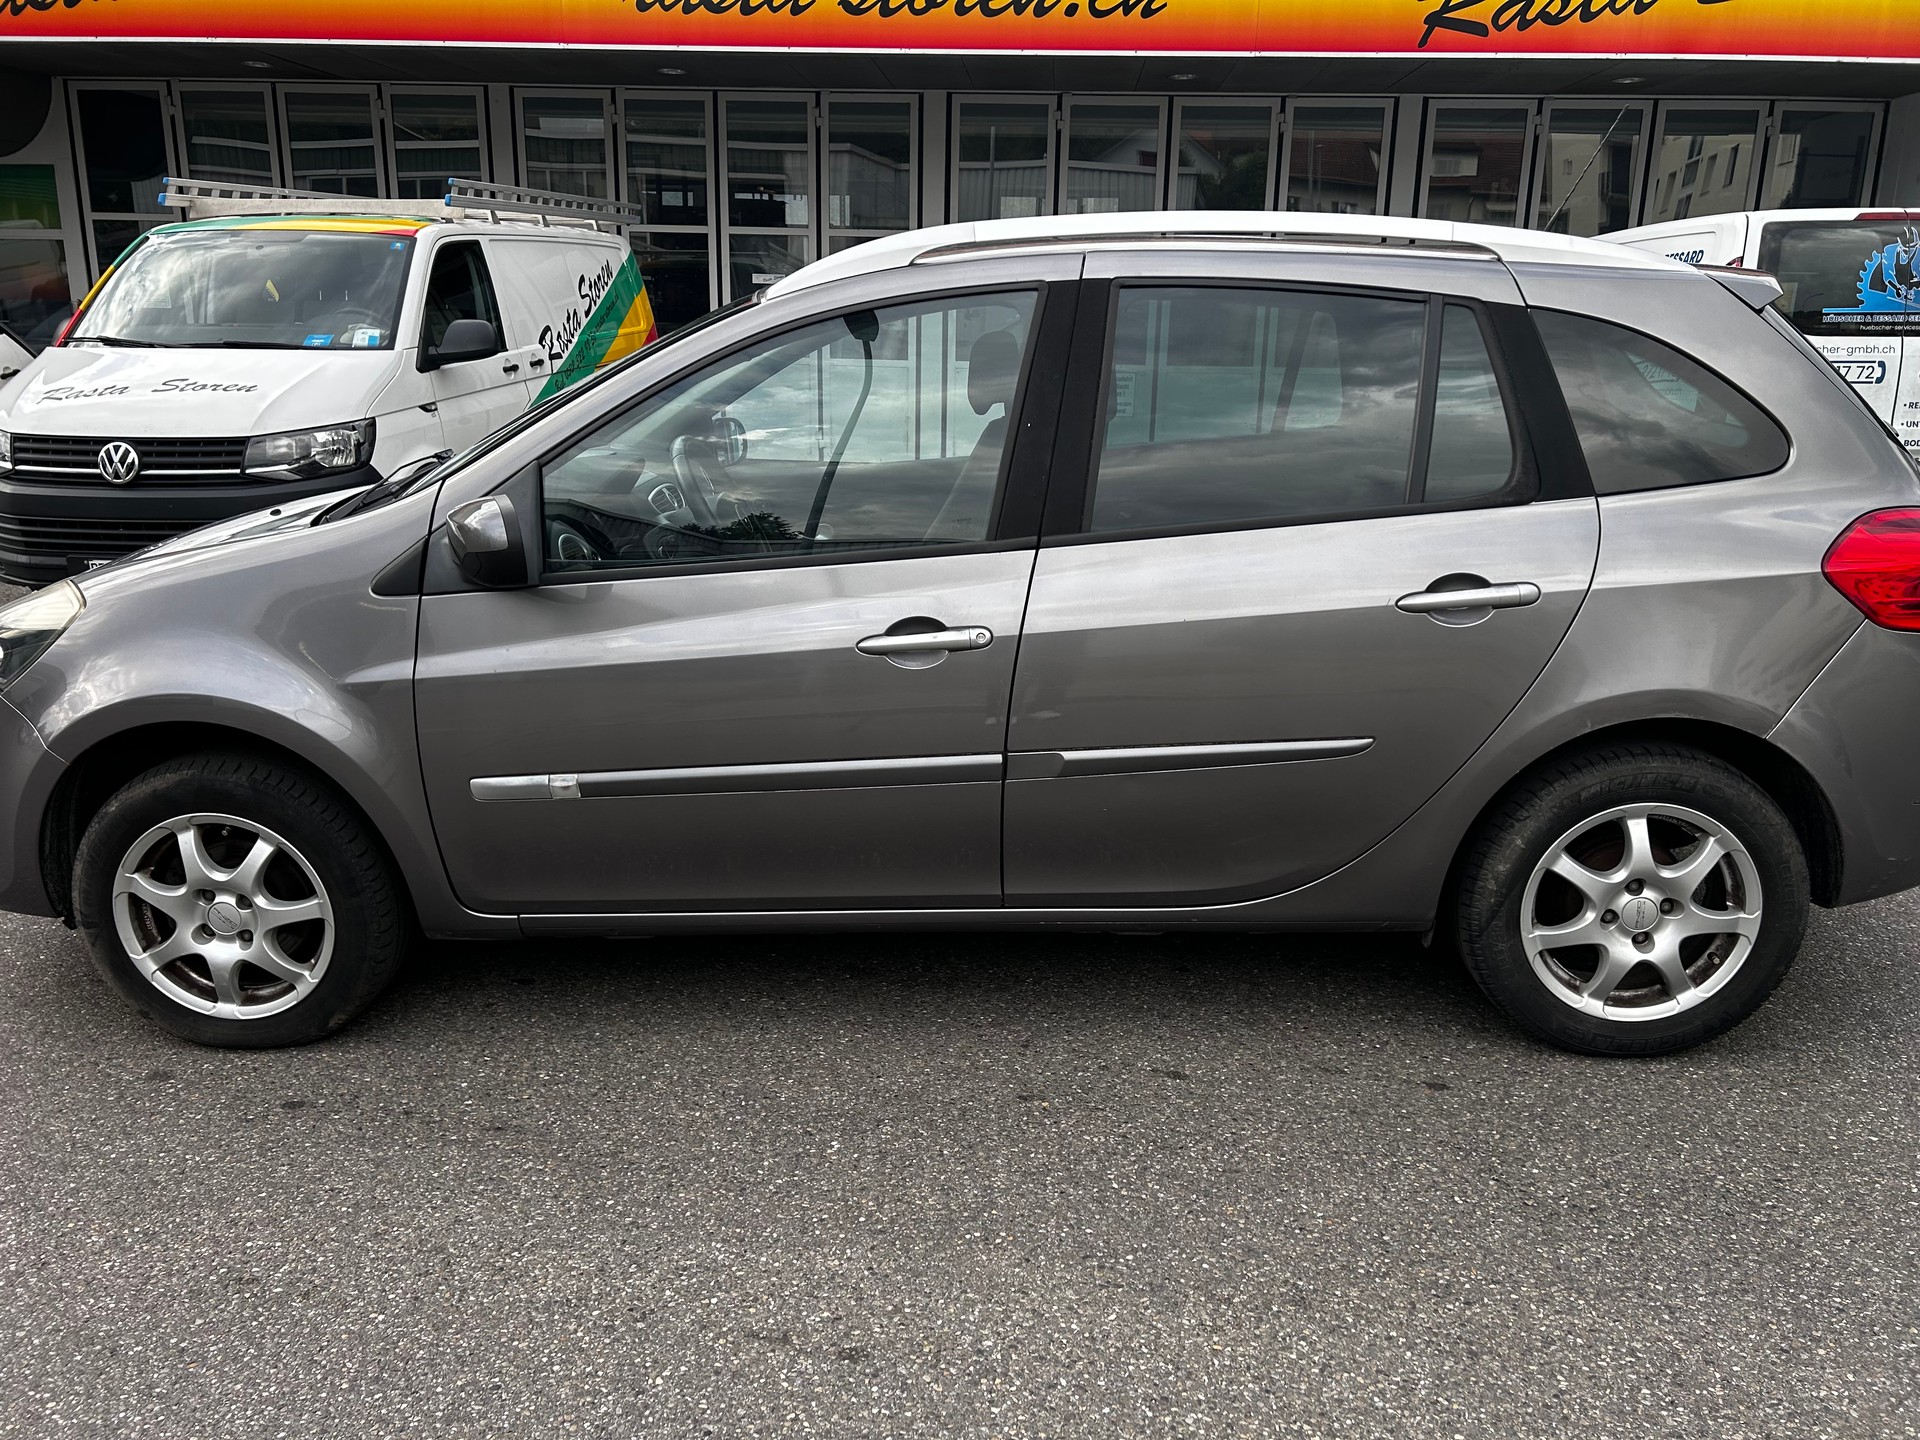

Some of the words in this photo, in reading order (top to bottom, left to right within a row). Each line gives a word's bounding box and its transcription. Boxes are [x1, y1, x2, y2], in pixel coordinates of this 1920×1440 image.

[1665, 249, 1704, 263] SSARD
[538, 308, 581, 361] Rasta
[578, 259, 614, 318] Storen
[1856, 365, 1875, 379] 72
[36, 384, 131, 404] Rasta
[151, 378, 258, 393] Storen
[1908, 402, 1920, 410] RE
